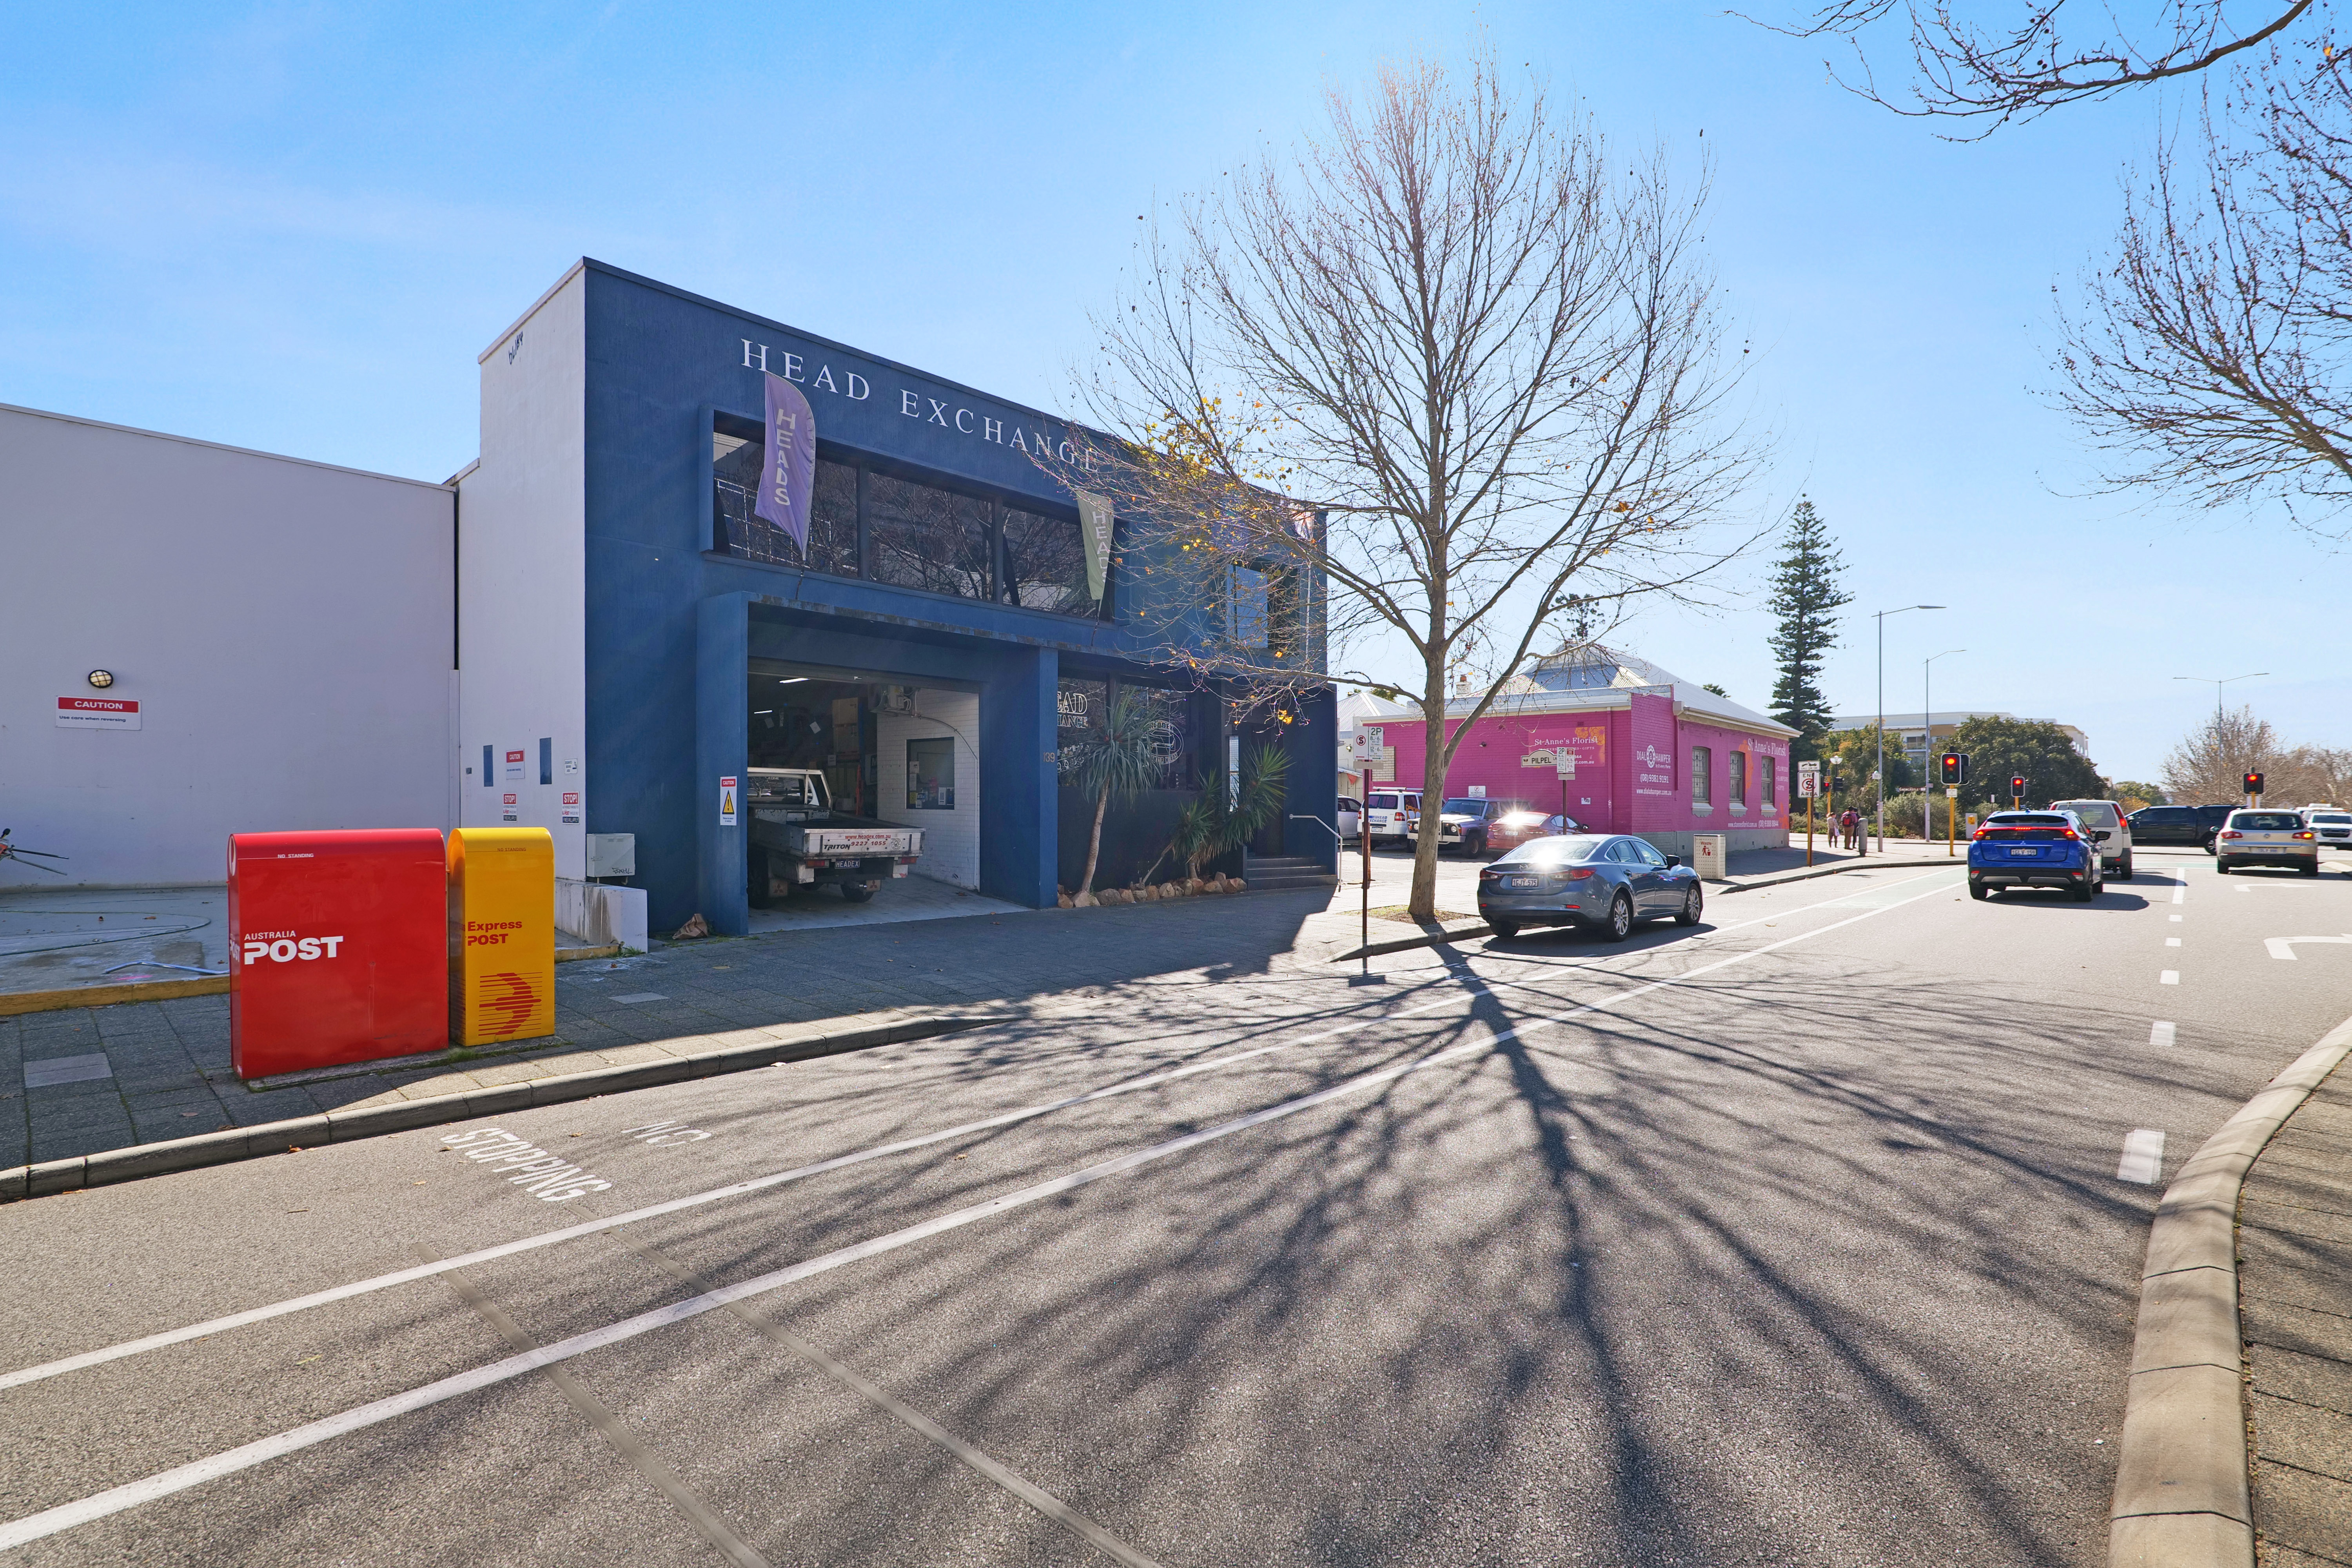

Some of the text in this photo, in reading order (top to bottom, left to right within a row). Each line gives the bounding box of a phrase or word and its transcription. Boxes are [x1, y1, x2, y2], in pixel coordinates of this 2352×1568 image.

[741, 338, 1099, 472] HEAD EXCHANGE
[774, 408, 797, 506] HEADS
[74, 701, 123, 710] CAUTION
[1572, 736, 1598, 744] Florist
[1748, 738, 1786, 756] St Anne's Florist
[1043, 752, 1055, 762] 139
[1637, 751, 1646, 760] DIAL
[1655, 753, 1671, 763] HAMPER
[1641, 773, 1649, 783] (08)
[1637, 788, 1671, 796] www.dialahamper.com.au
[564, 794, 577, 803] STOP!
[468, 921, 522, 933] Express
[244, 930, 296, 940] AUSTRALIA
[468, 933, 508, 946] POST
[244, 936, 343, 965] POST
[440, 1128, 612, 1202] STOPPING
